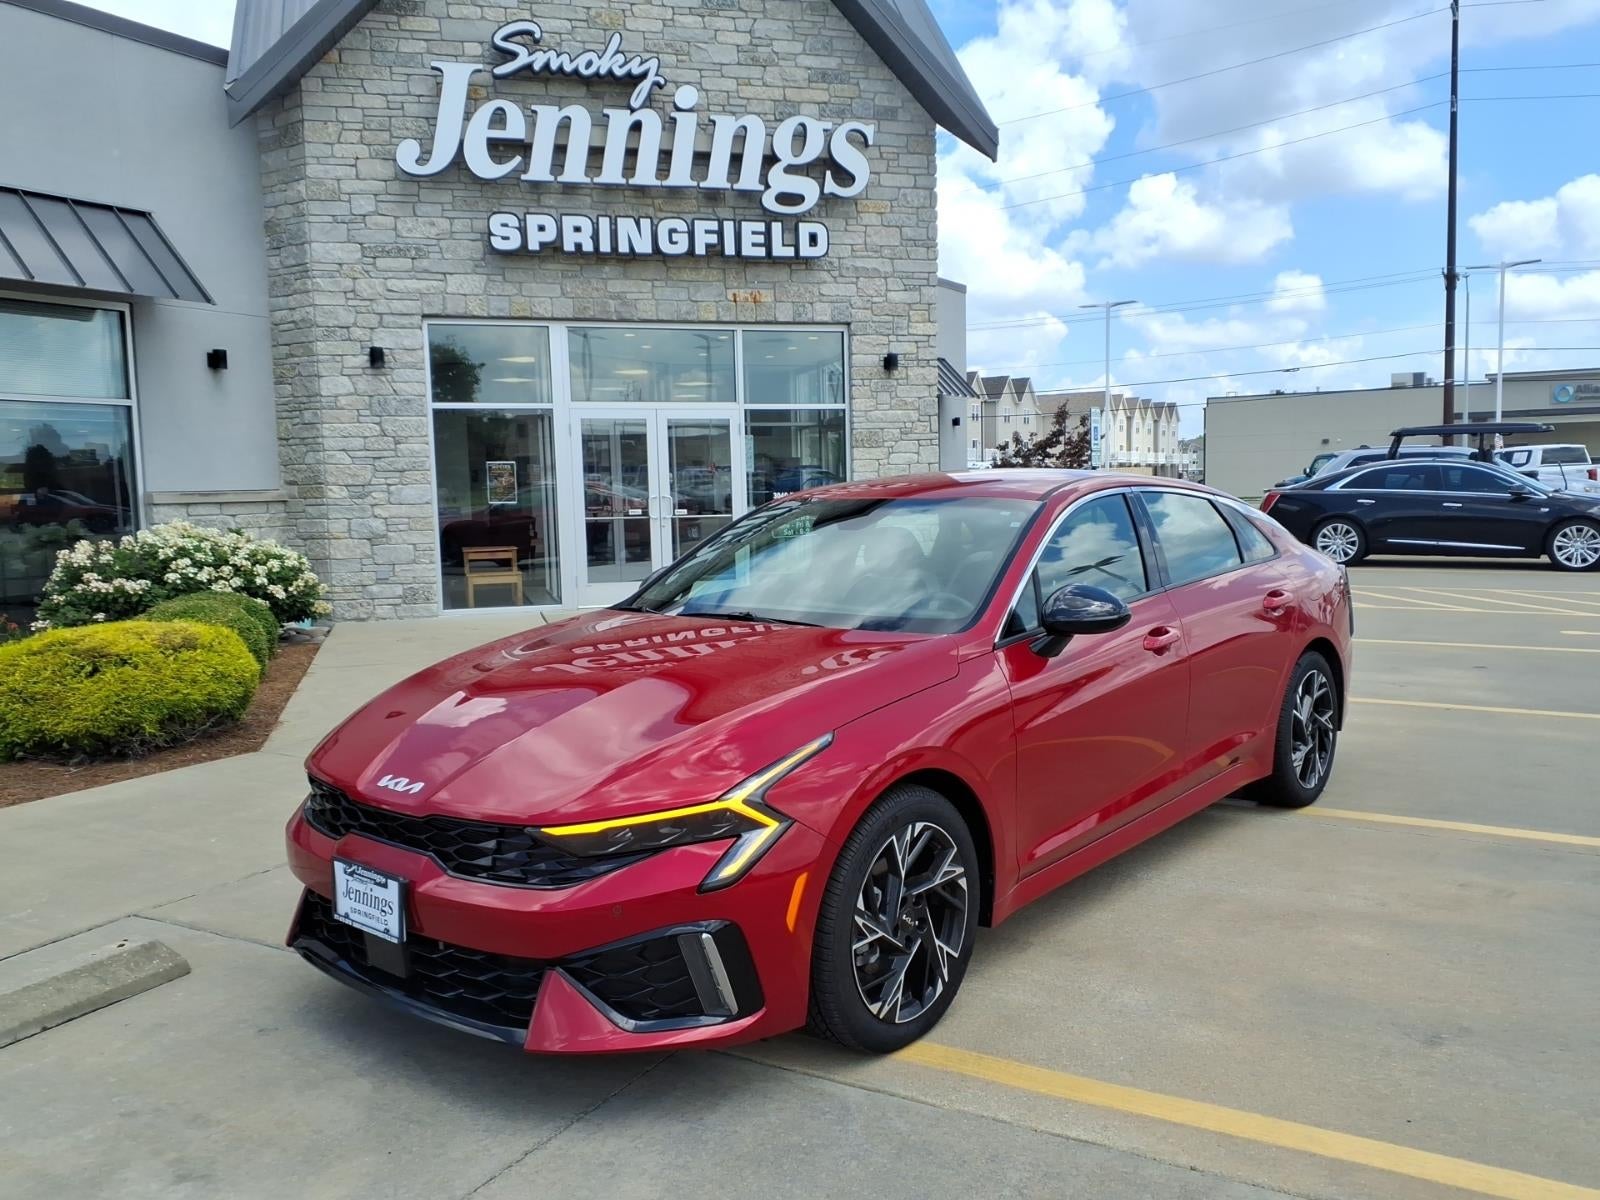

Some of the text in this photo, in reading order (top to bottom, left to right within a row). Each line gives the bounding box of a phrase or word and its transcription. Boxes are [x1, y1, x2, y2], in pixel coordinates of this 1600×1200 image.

[491, 19, 666, 110] Smoky
[395, 60, 875, 215] Jennings
[488, 212, 830, 258] SPRINGFIELD
[377, 774, 425, 794] KIA
[342, 879, 394, 917] Jennings
[350, 907, 389, 926] SPRINGFIELD
